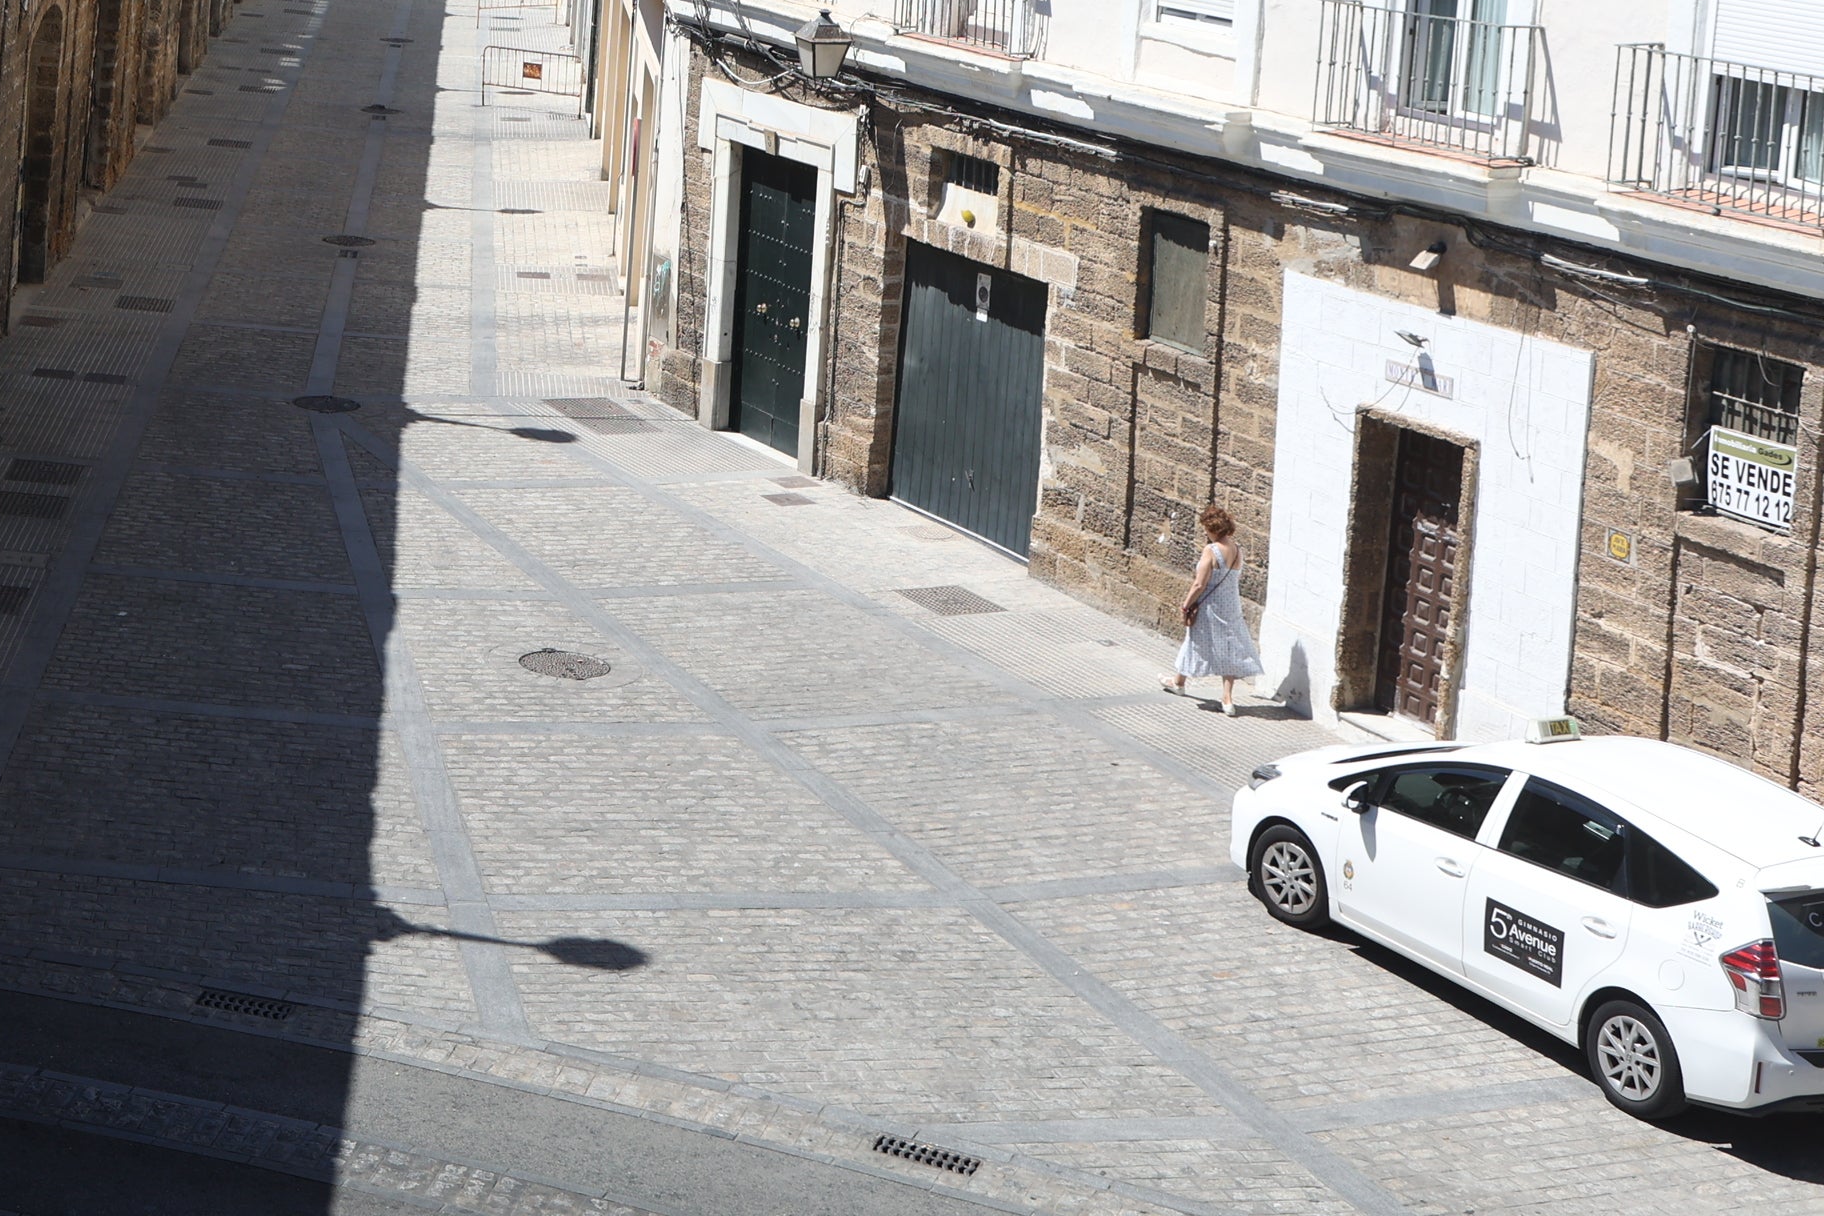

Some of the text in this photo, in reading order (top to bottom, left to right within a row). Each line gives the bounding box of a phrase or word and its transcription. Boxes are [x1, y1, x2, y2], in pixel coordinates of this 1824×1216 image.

[1714, 434, 1757, 454] Inmobiliaria
[1711, 453, 1793, 498] SE VENDE
[1711, 480, 1790, 523] 675 77 12 12
[1517, 919, 1558, 942] GIMNASIO
[1694, 910, 1723, 929] Wicket
[1508, 936, 1532, 952] Smart
[1537, 950, 1556, 963] Club
[1509, 923, 1557, 957] Avenue
